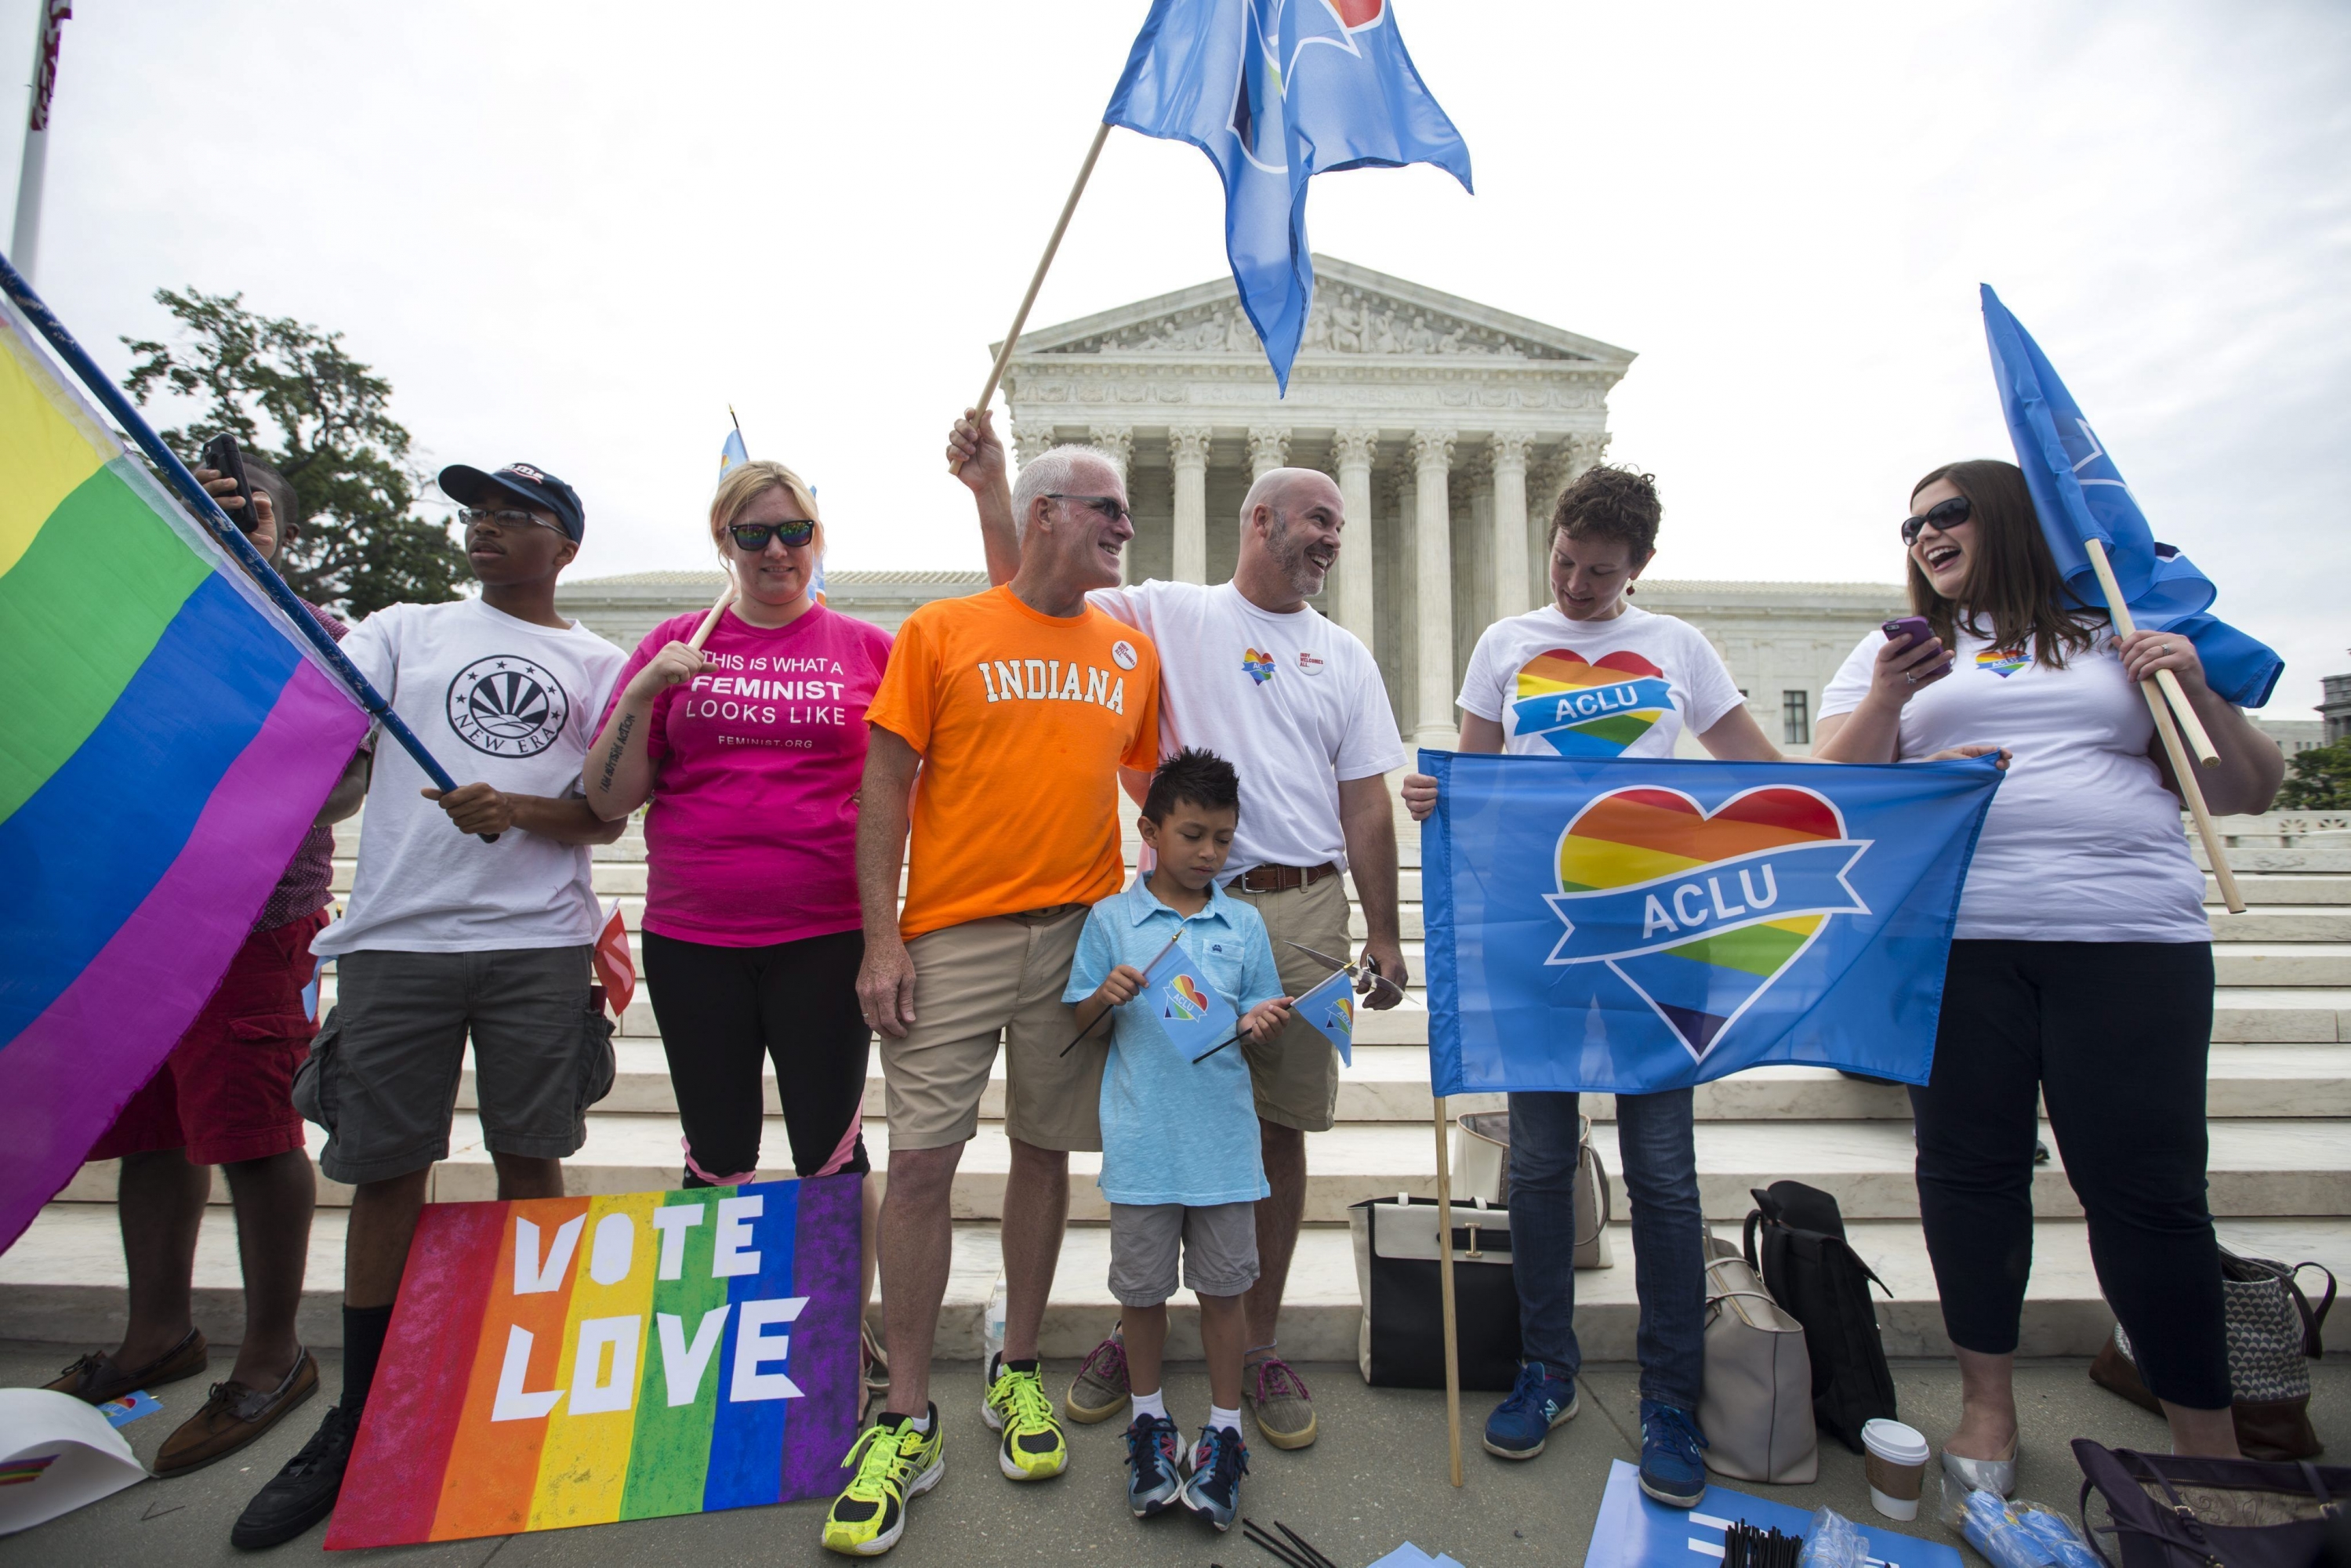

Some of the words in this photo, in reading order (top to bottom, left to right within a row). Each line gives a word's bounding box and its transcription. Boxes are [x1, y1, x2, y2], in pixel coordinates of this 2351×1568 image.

[749, 657, 767, 670] IS
[773, 656, 828, 672] WHAT
[830, 662, 844, 675] A
[691, 676, 844, 700] FEMINIST
[978, 659, 1123, 716] INDIANA
[1555, 685, 1638, 722] ACLU
[687, 700, 776, 724] LOOKS
[790, 706, 845, 725] LIKE
[454, 713, 506, 751] NEW
[517, 727, 556, 753] ERA
[718, 735, 813, 749] FEMINIST.ORG
[1642, 862, 1778, 939] ACLU
[1173, 993, 1195, 1011] ACLU
[513, 1194, 764, 1296] VOTE
[491, 1296, 811, 1422] LOVE
